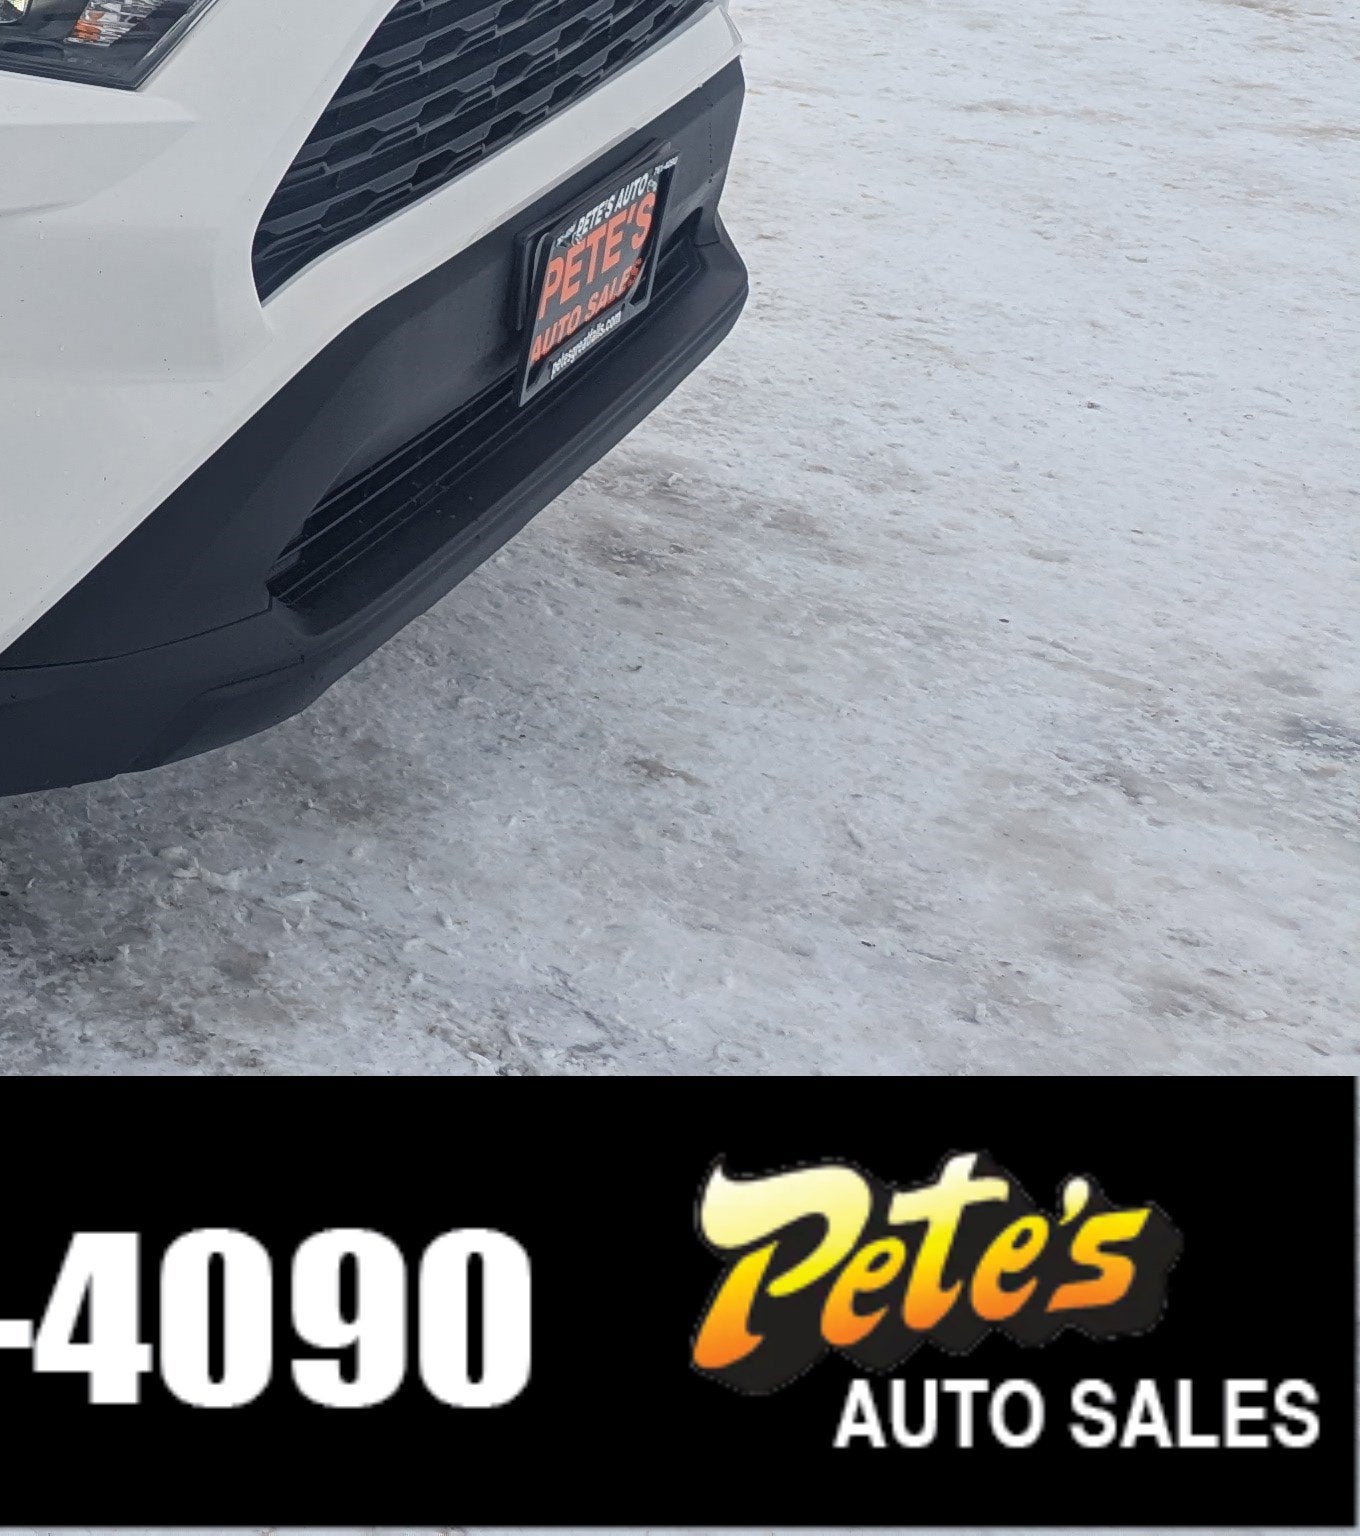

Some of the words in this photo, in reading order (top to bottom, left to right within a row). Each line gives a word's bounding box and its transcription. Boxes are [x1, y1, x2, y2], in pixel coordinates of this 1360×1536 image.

[538, 192, 656, 320] PETE'S
[577, 194, 616, 234] PETE'S
[613, 172, 650, 213] AUTO
[530, 304, 582, 363] AUTO
[584, 257, 643, 322] SALES
